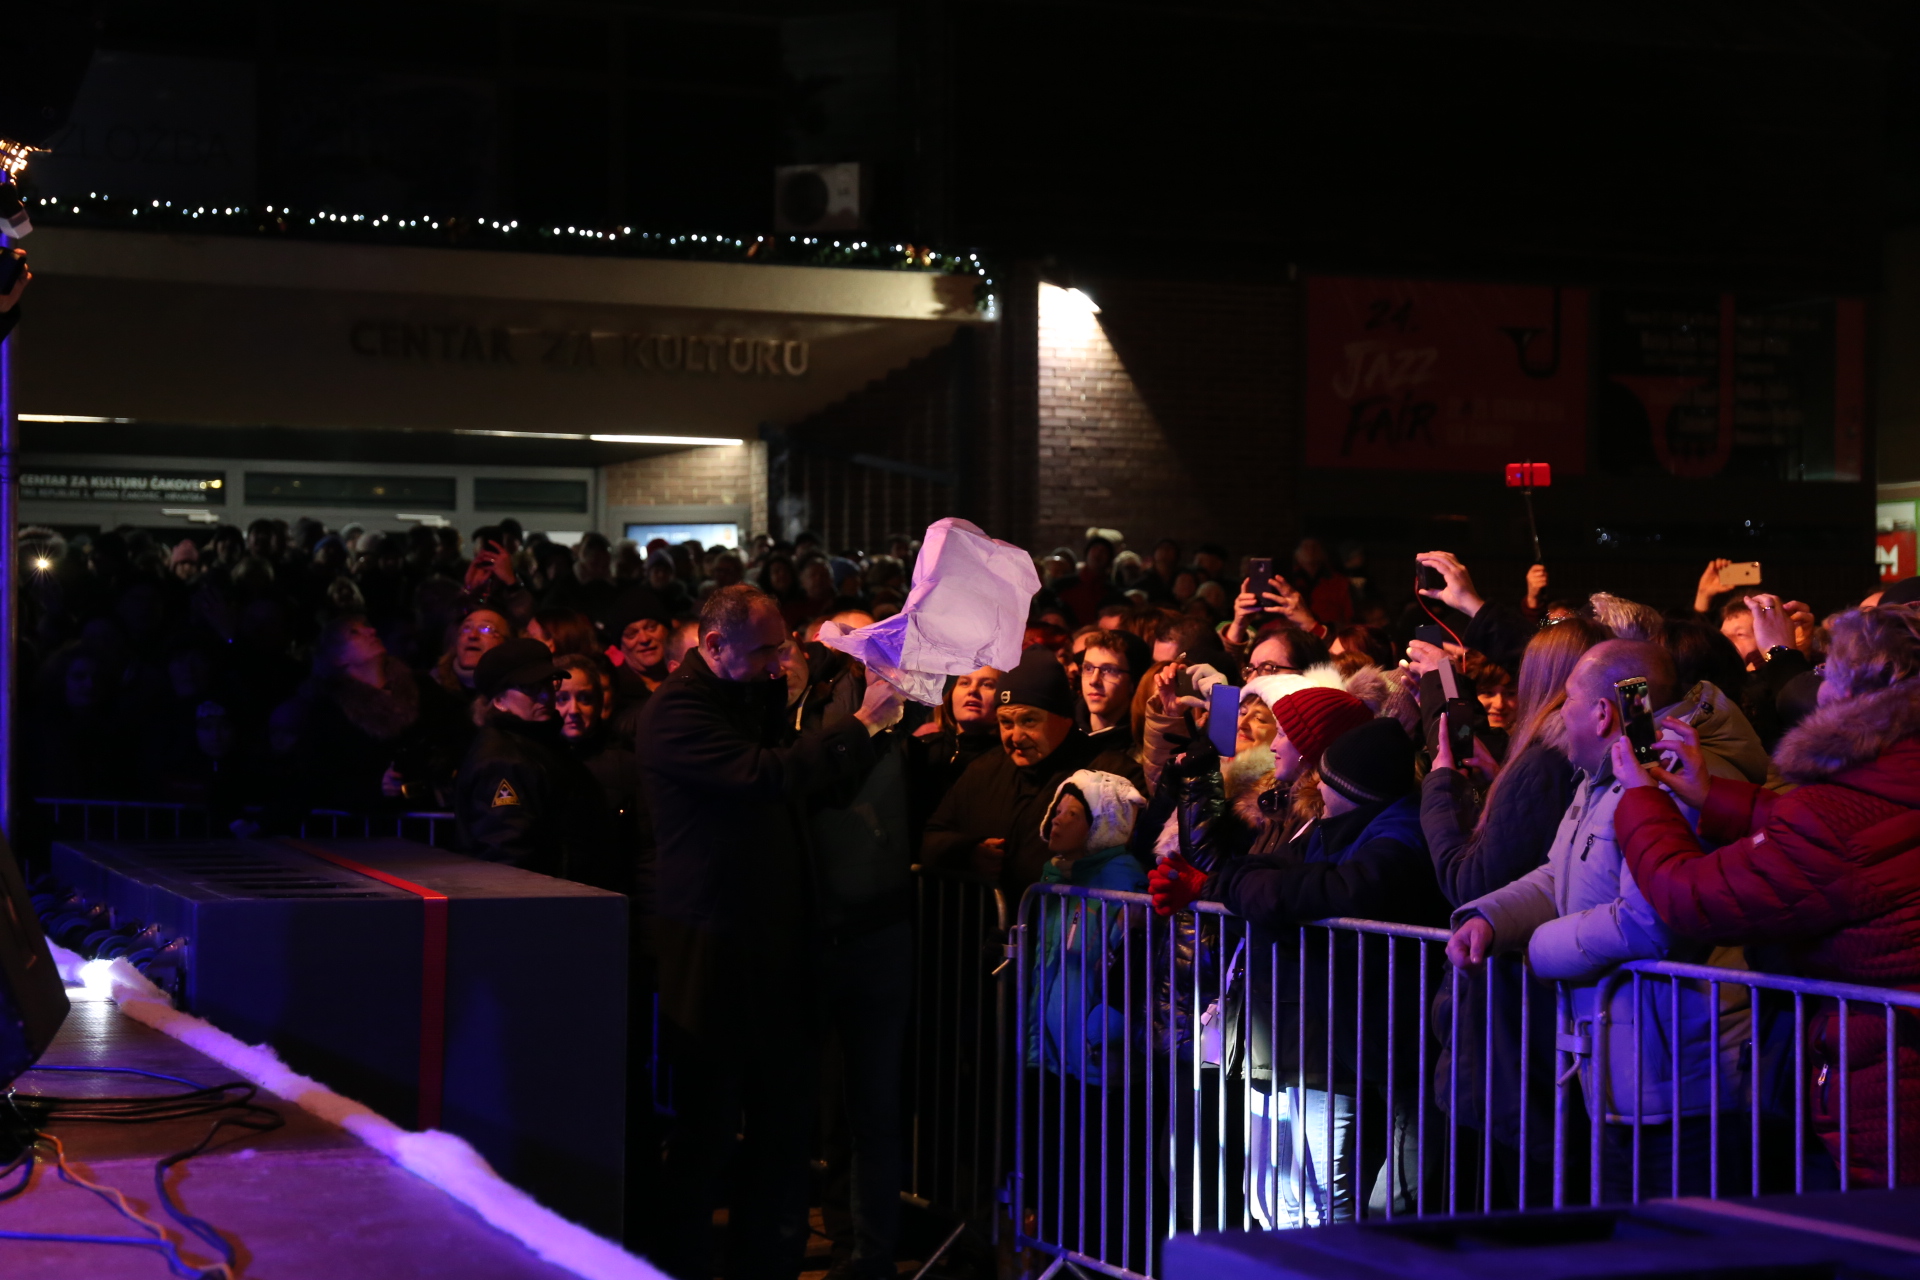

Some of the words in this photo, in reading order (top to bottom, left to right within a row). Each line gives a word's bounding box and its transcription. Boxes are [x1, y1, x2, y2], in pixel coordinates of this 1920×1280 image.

[50, 121, 232, 168] ZLOŽBA
[350, 319, 518, 366] CENTAR
[541, 329, 597, 367] ZA
[622, 334, 809, 376] KULTURU
[1332, 339, 1439, 399] JAZZ
[19, 474, 68, 486] CENTAR
[70, 475, 88, 487] ZA
[90, 476, 148, 489] KULTURU
